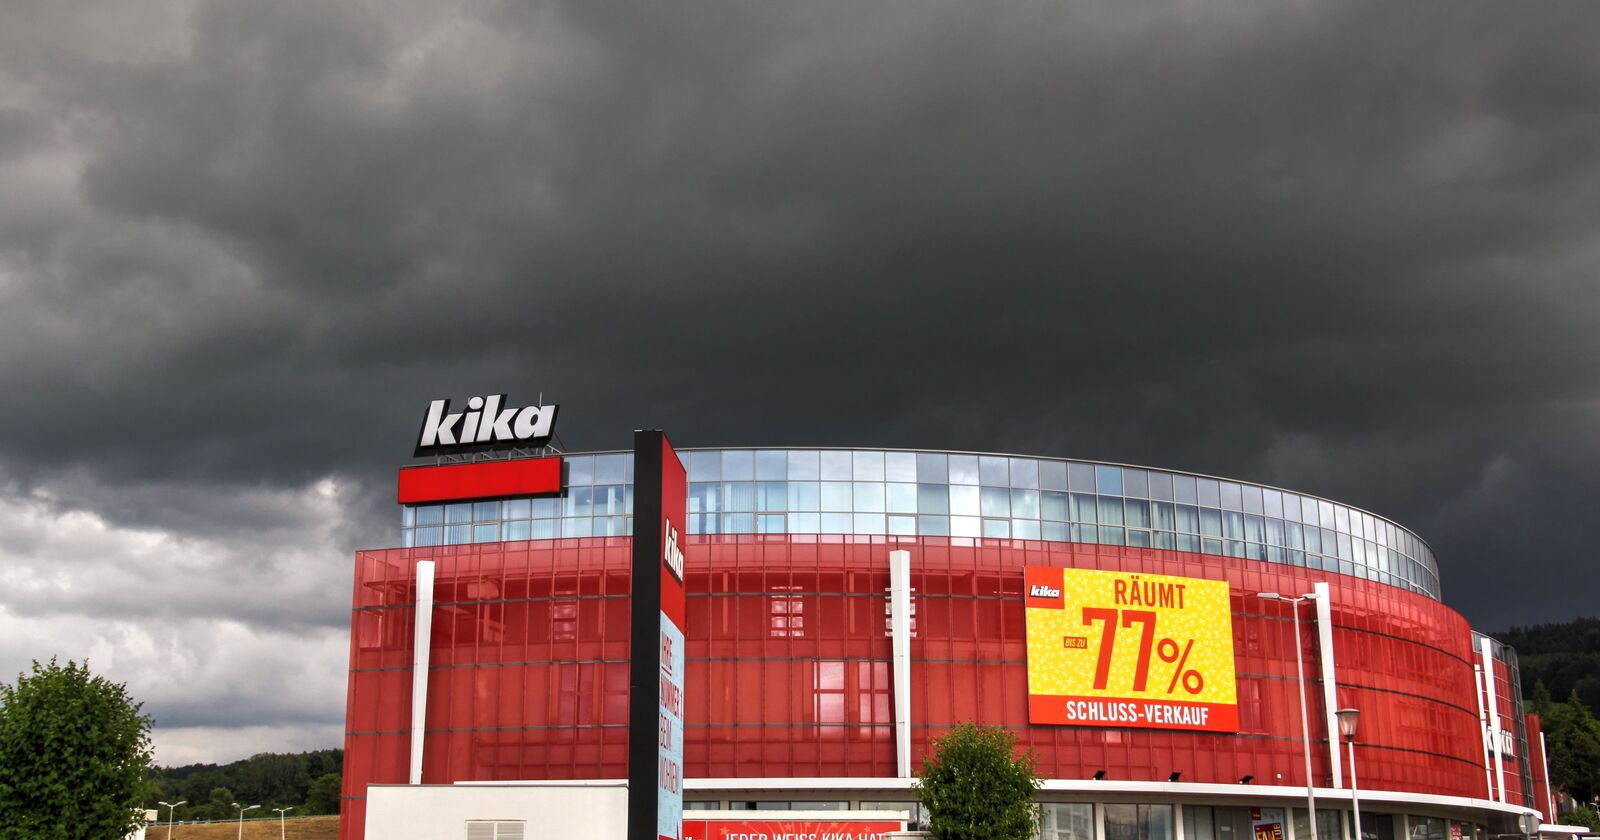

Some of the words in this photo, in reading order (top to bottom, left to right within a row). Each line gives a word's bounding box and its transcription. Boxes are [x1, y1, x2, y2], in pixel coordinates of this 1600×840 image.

[420, 394, 556, 447] kika
[664, 518, 685, 582] kika
[1030, 585, 1061, 598] kika
[1114, 575, 1186, 609] RÄUMT
[1065, 638, 1077, 647] BIS
[1077, 639, 1086, 648] ZU
[1082, 606, 1204, 695] 77%
[1066, 701, 1209, 726] SCHLUSS-VERKAUF
